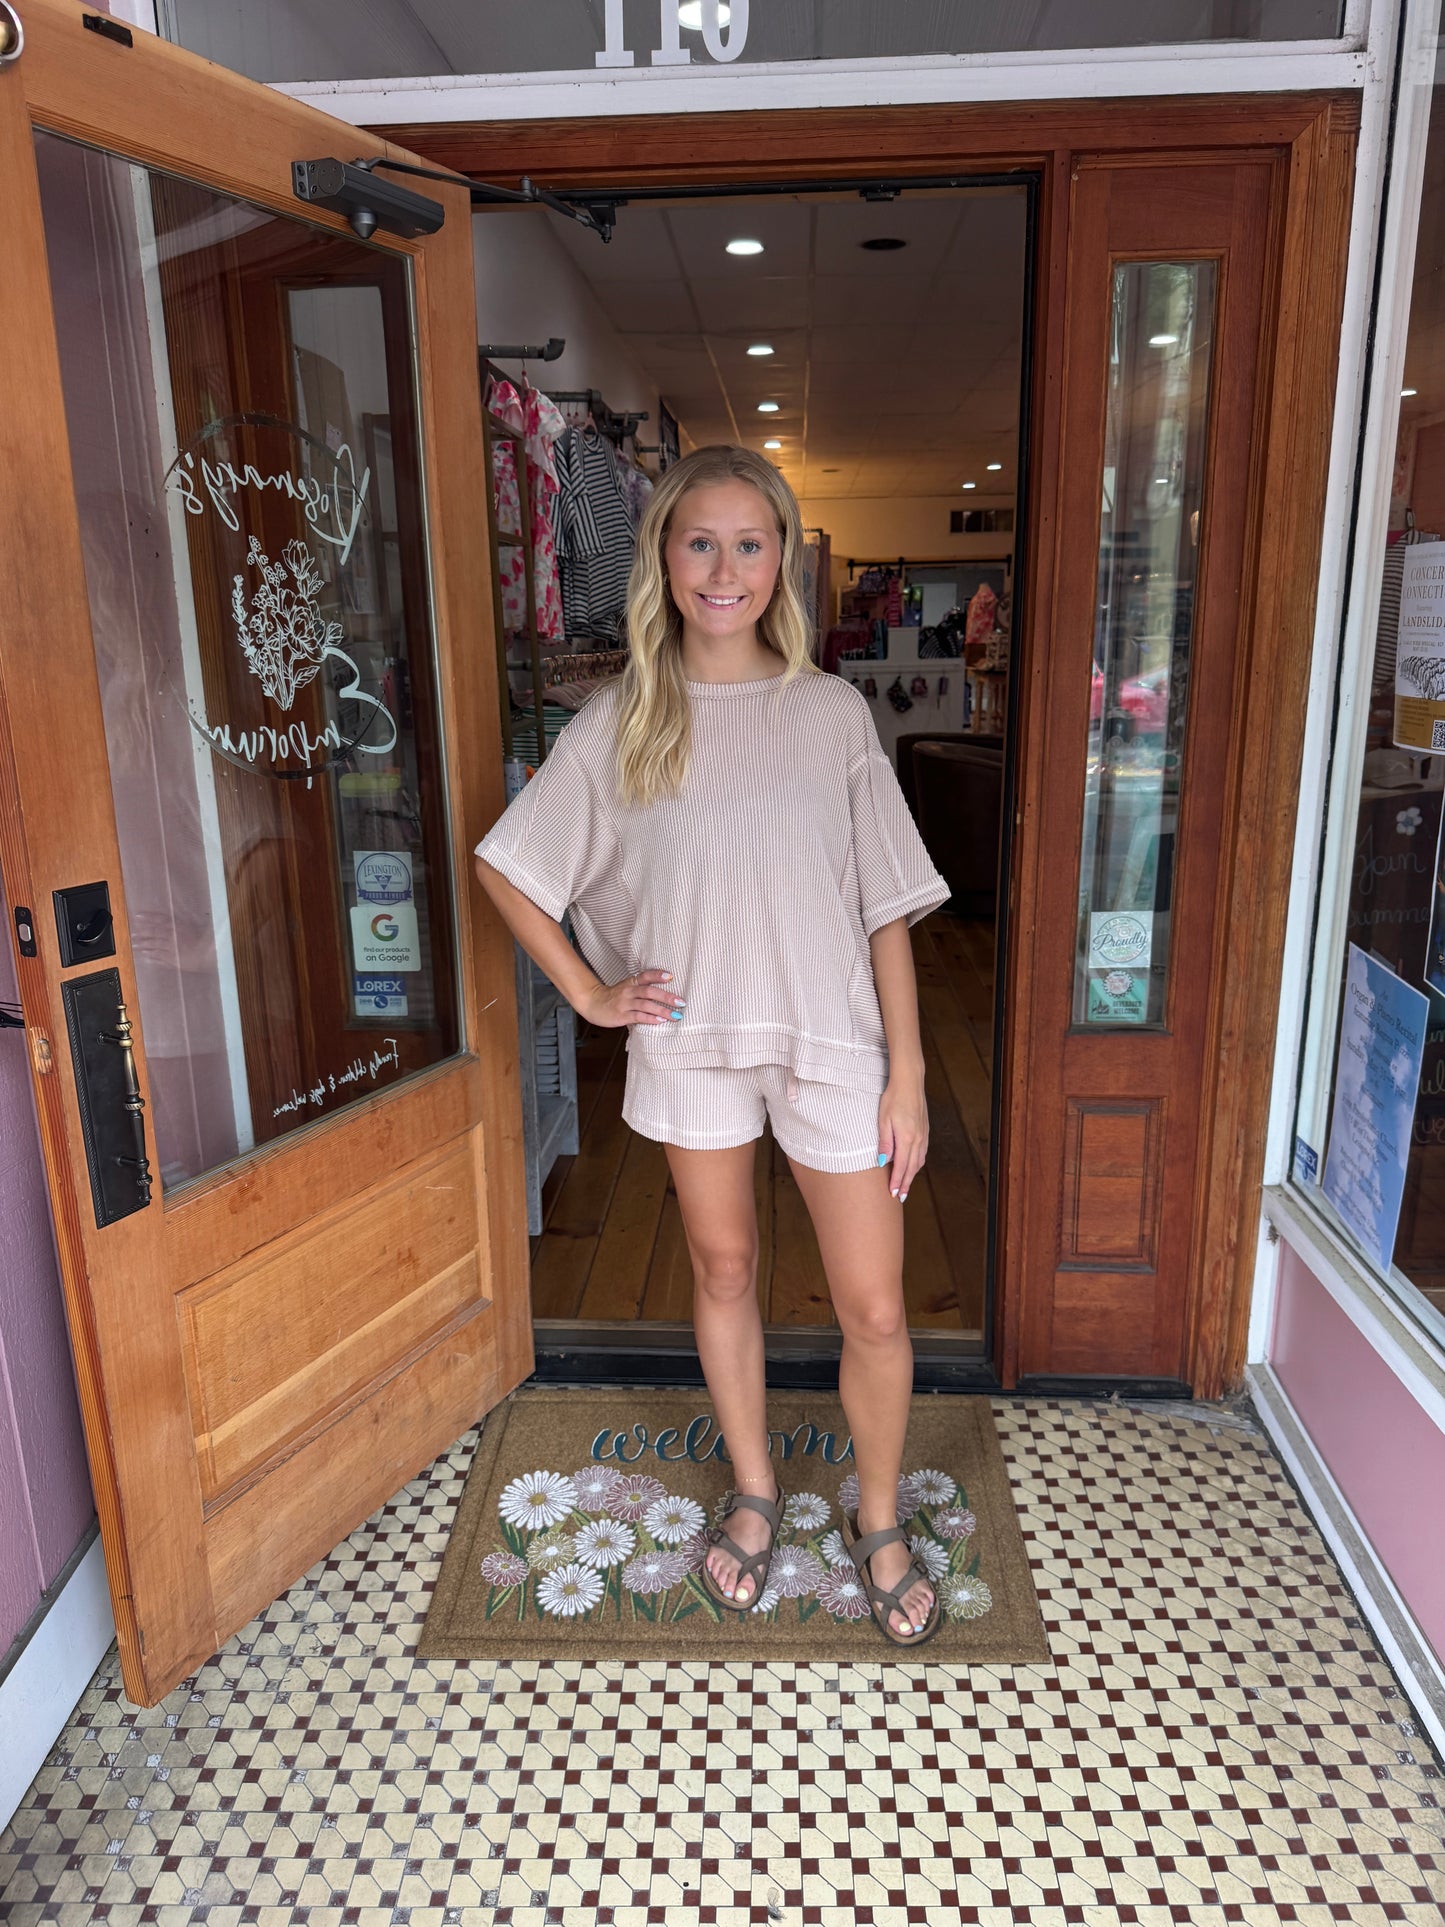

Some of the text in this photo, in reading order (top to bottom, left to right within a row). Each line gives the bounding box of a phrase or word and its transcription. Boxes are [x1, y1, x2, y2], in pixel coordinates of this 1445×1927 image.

[1403, 585, 1445, 600] CONNECTI
[364, 864, 403, 877] LEXINGTON
[1092, 931, 1149, 952] Proudly
[378, 954, 410, 963] Google
[356, 981, 402, 992] LOREX
[590, 1414, 856, 1465] welcm
